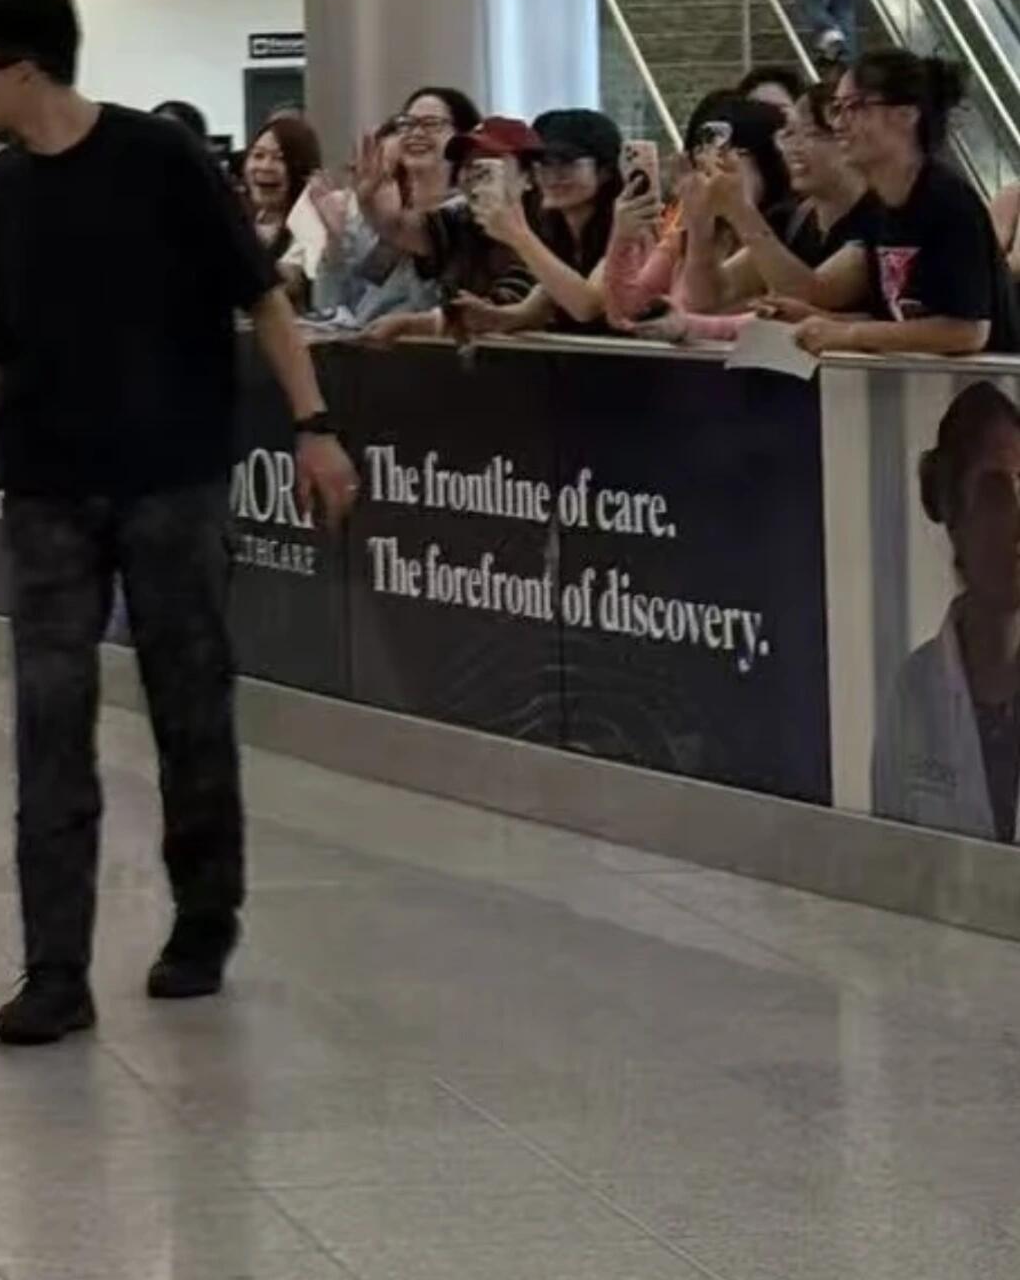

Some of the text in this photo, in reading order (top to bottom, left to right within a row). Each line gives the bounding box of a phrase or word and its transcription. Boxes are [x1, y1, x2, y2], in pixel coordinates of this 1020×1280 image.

[365, 445, 676, 538] The frontline of care.
[367, 537, 770, 672] The forefront of discovery.
